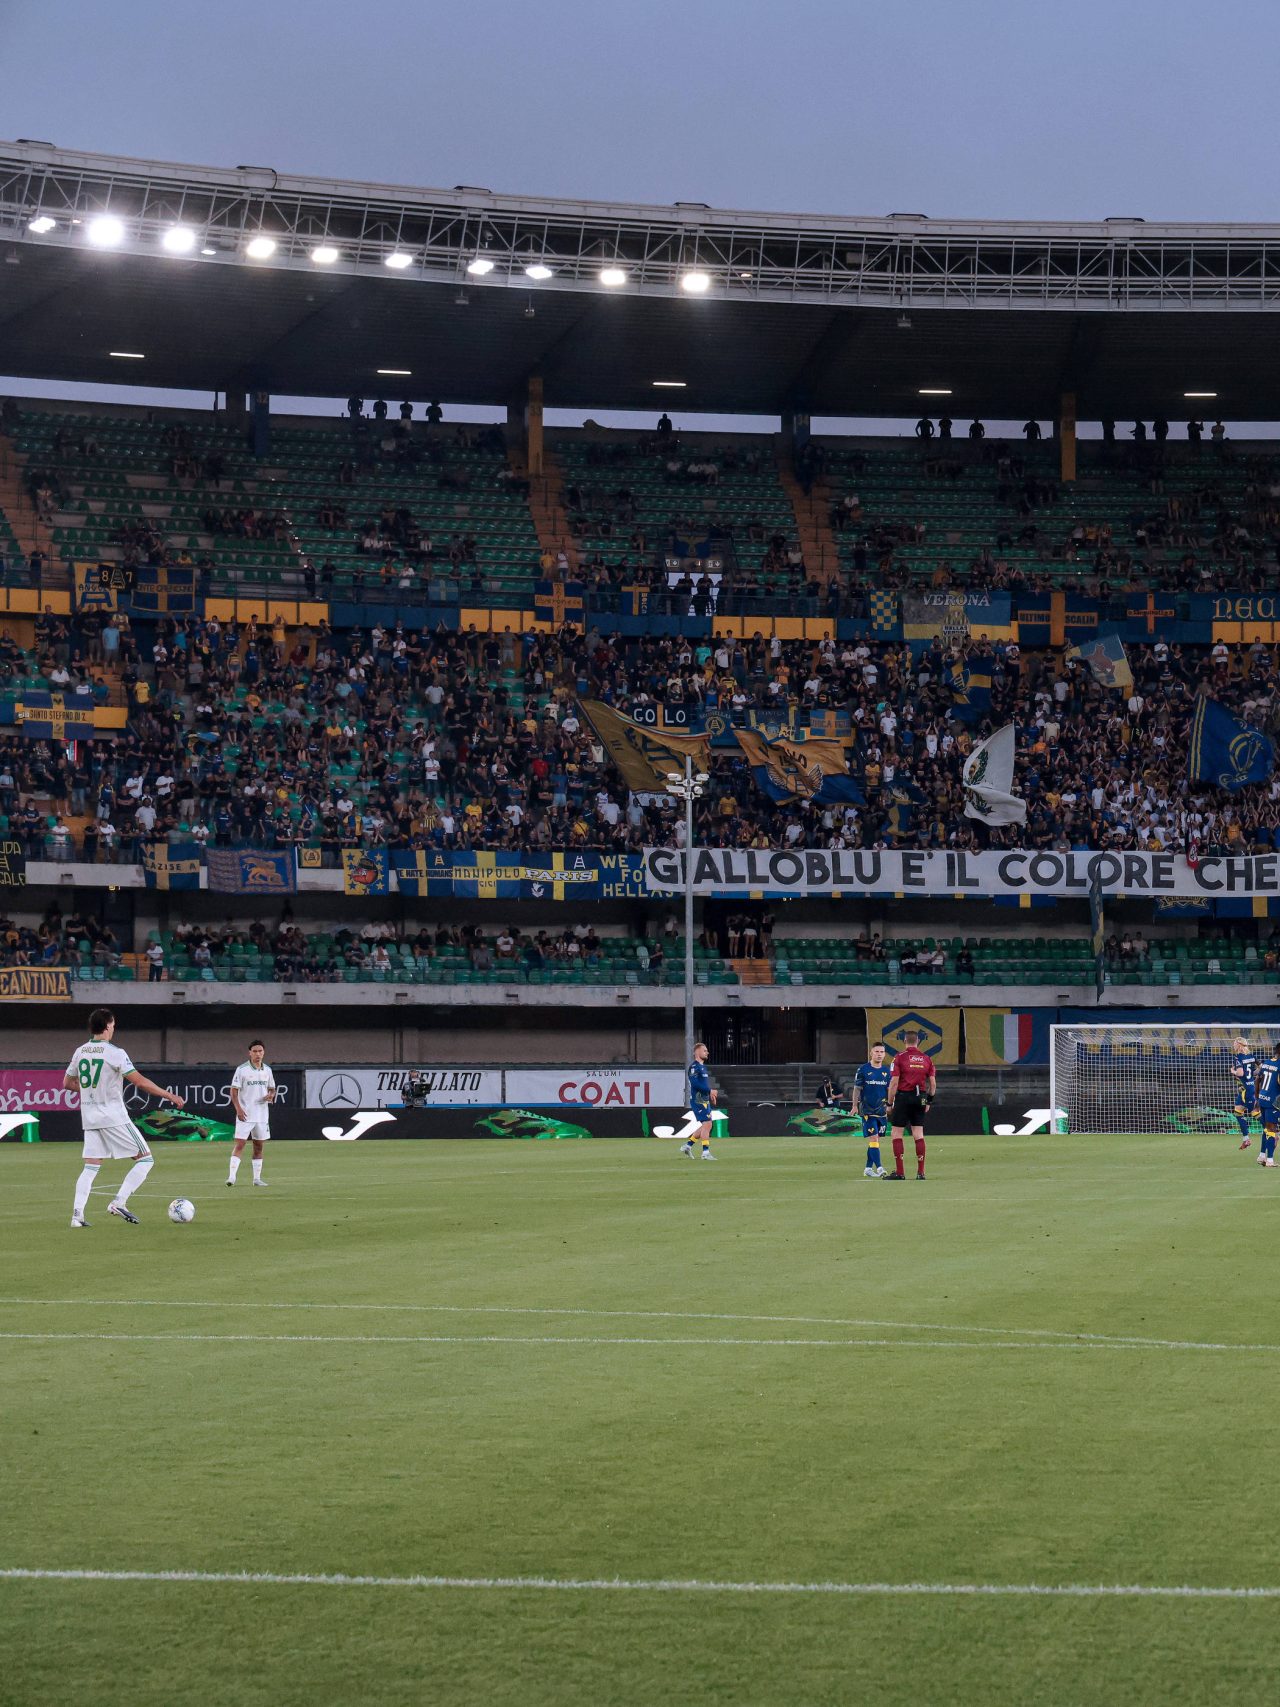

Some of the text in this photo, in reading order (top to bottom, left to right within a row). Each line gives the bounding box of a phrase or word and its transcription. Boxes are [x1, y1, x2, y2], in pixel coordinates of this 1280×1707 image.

[923, 594, 991, 608] VERONA
[600, 855, 629, 869] WE
[649, 850, 882, 886] GIALLOBLU
[946, 852, 980, 887] IL
[998, 852, 1175, 889] COLORE
[1194, 855, 1279, 892] CHE
[525, 869, 593, 881] PARIS
[78, 1058, 105, 1089] 87
[1246, 1064, 1252, 1080] 5
[1261, 1071, 1273, 1091] 11
[558, 1081, 651, 1105] COATI
